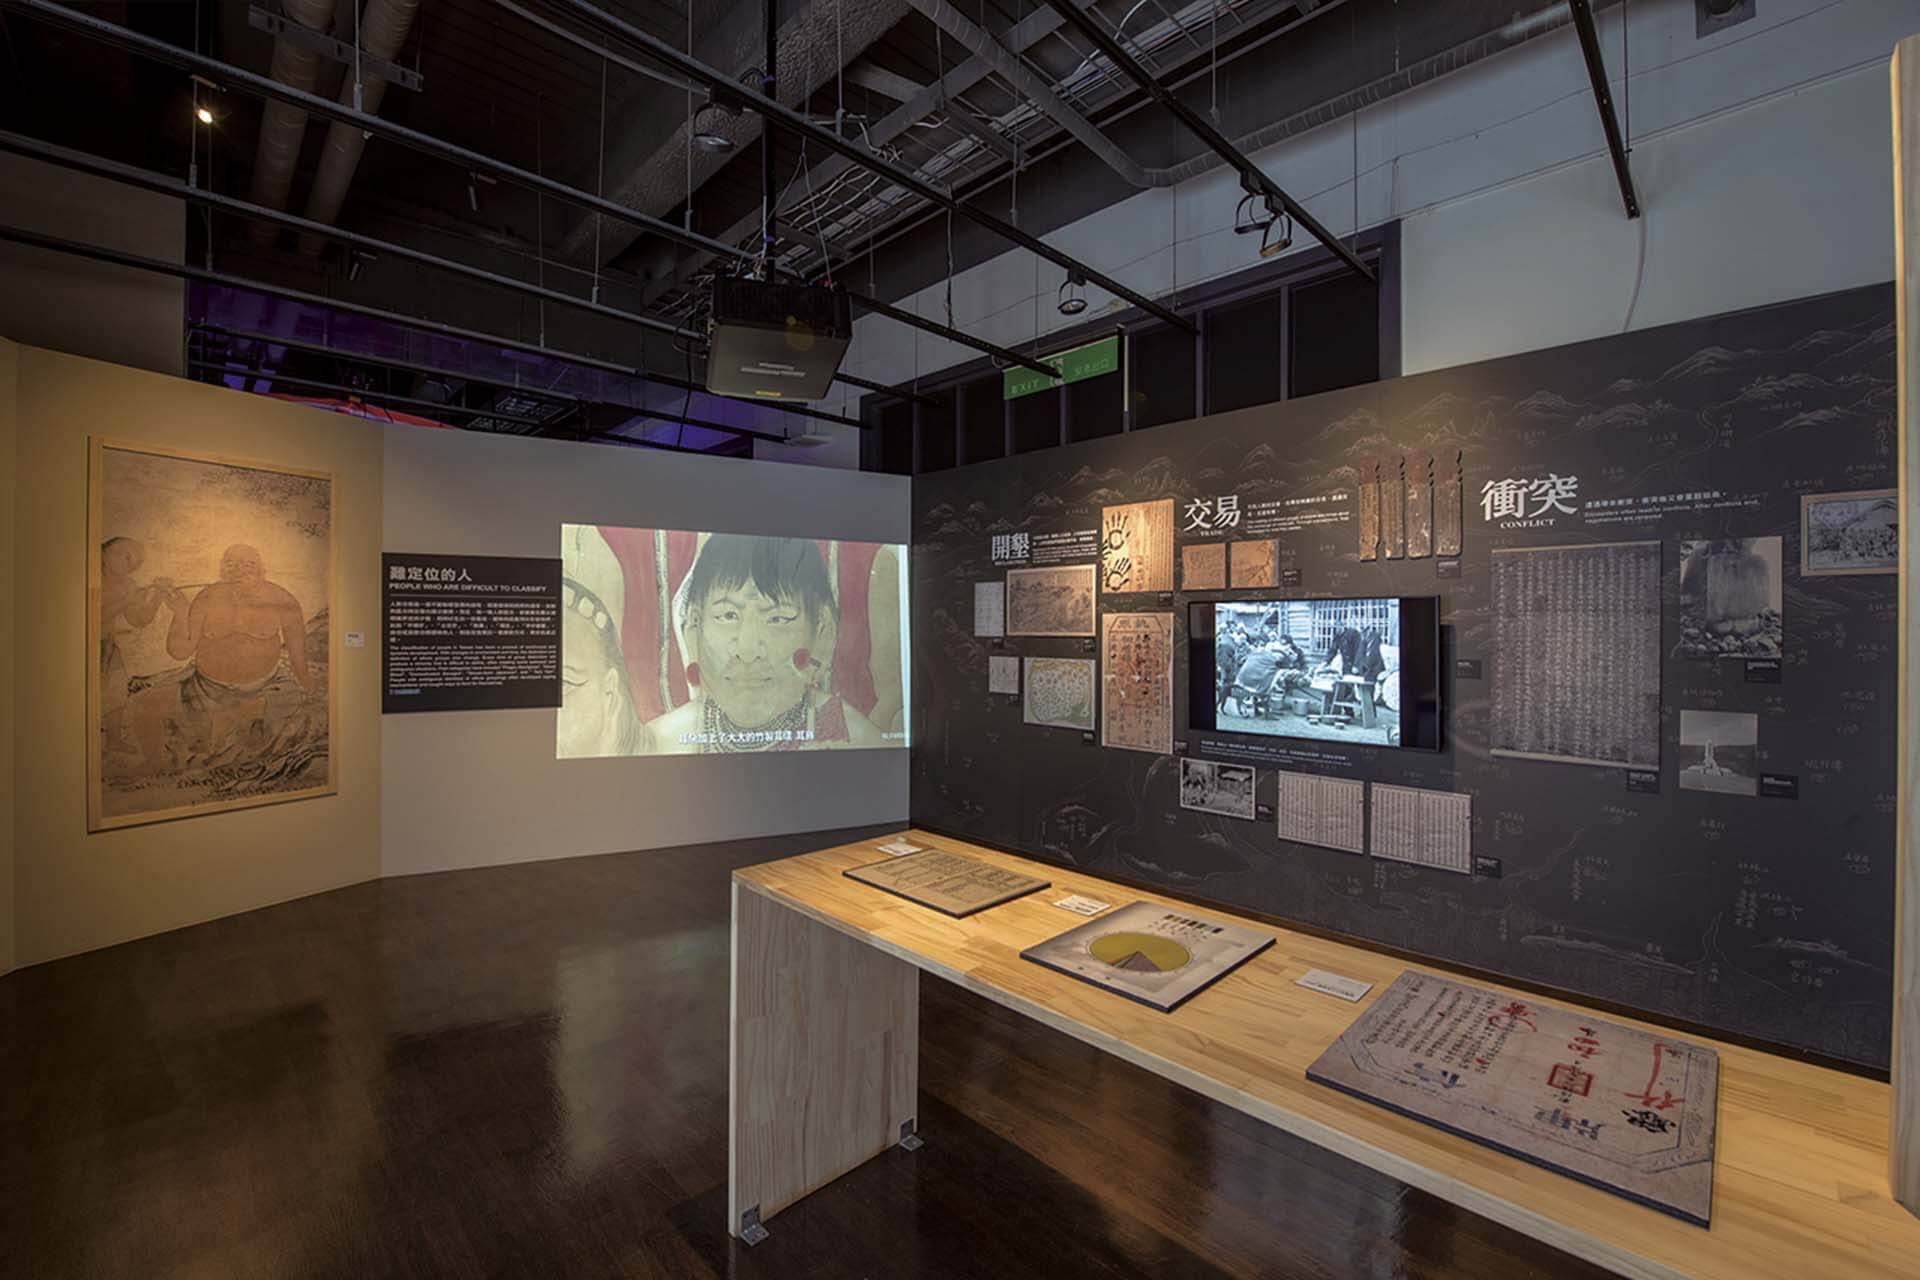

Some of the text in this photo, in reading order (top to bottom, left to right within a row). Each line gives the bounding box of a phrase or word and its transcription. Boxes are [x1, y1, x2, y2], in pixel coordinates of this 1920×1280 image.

[1010, 378, 1039, 395] EXIT
[1479, 473, 1578, 521] 衝突
[1184, 494, 1241, 532] 交易
[1500, 519, 1556, 529] CONFLICT
[992, 532, 1030, 561] 開墾
[389, 565, 473, 582] 難定位的人
[389, 583, 421, 591] PEOPLE
[422, 583, 442, 591] WHO
[460, 584, 498, 592] DIFFICULT
[511, 585, 547, 593] CLASSIFY
